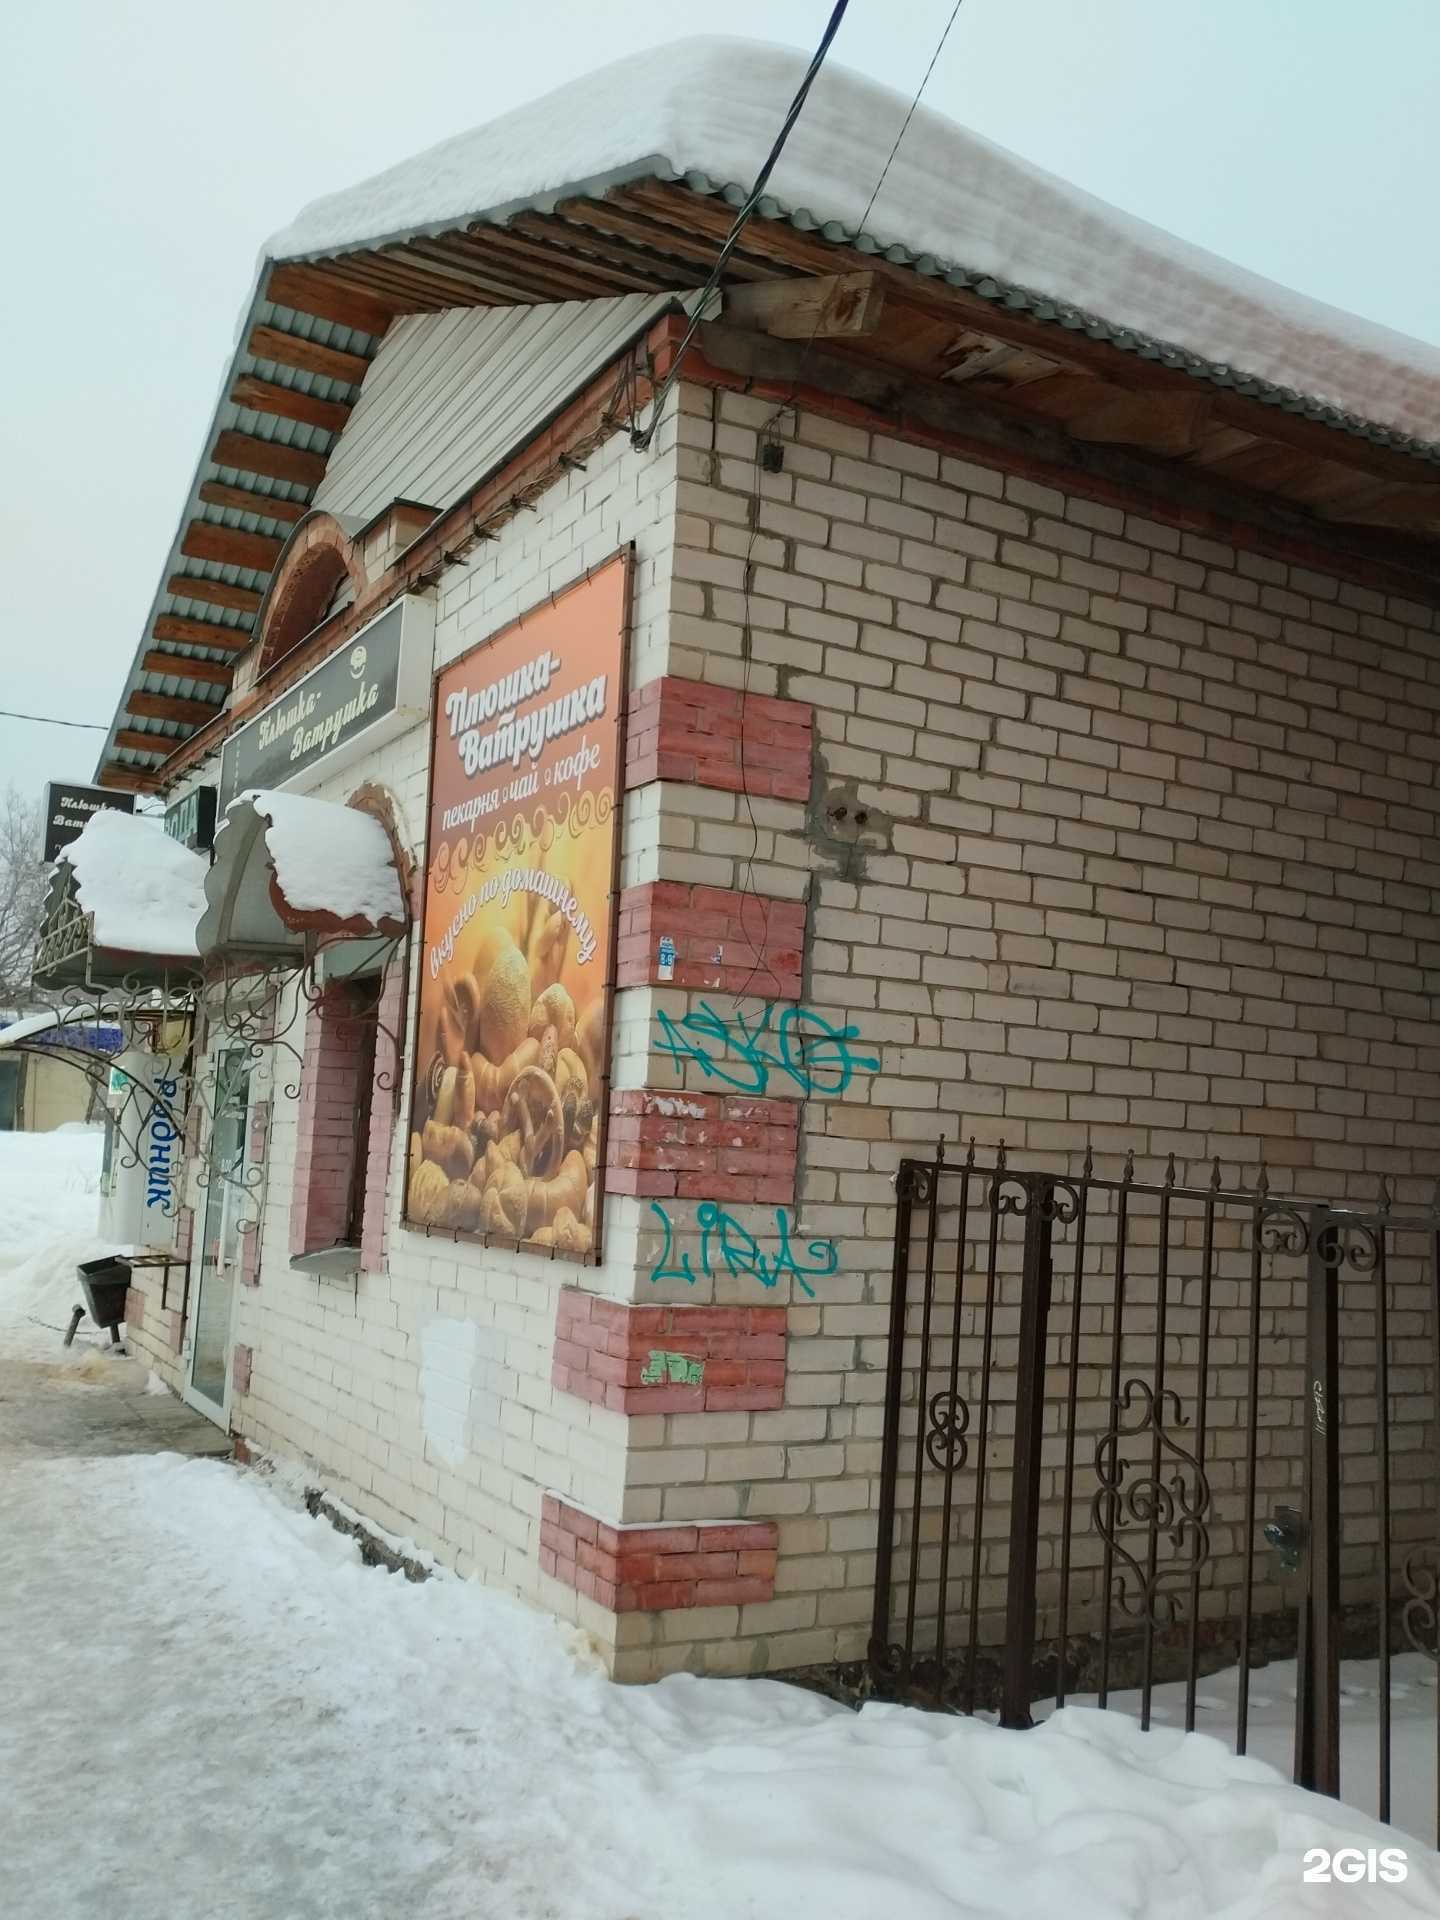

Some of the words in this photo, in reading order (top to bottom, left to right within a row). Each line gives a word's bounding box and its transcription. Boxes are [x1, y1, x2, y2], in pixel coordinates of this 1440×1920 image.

[259, 690, 322, 750] Плюшка-
[290, 682, 379, 760] Ватрушка
[446, 650, 561, 737] Плюшка-
[458, 674, 607, 776] Ватрушка
[442, 788, 500, 832] пекарня
[510, 762, 539, 801] чай
[553, 735, 600, 791] кофе
[147, 1076, 178, 1209] Родник
